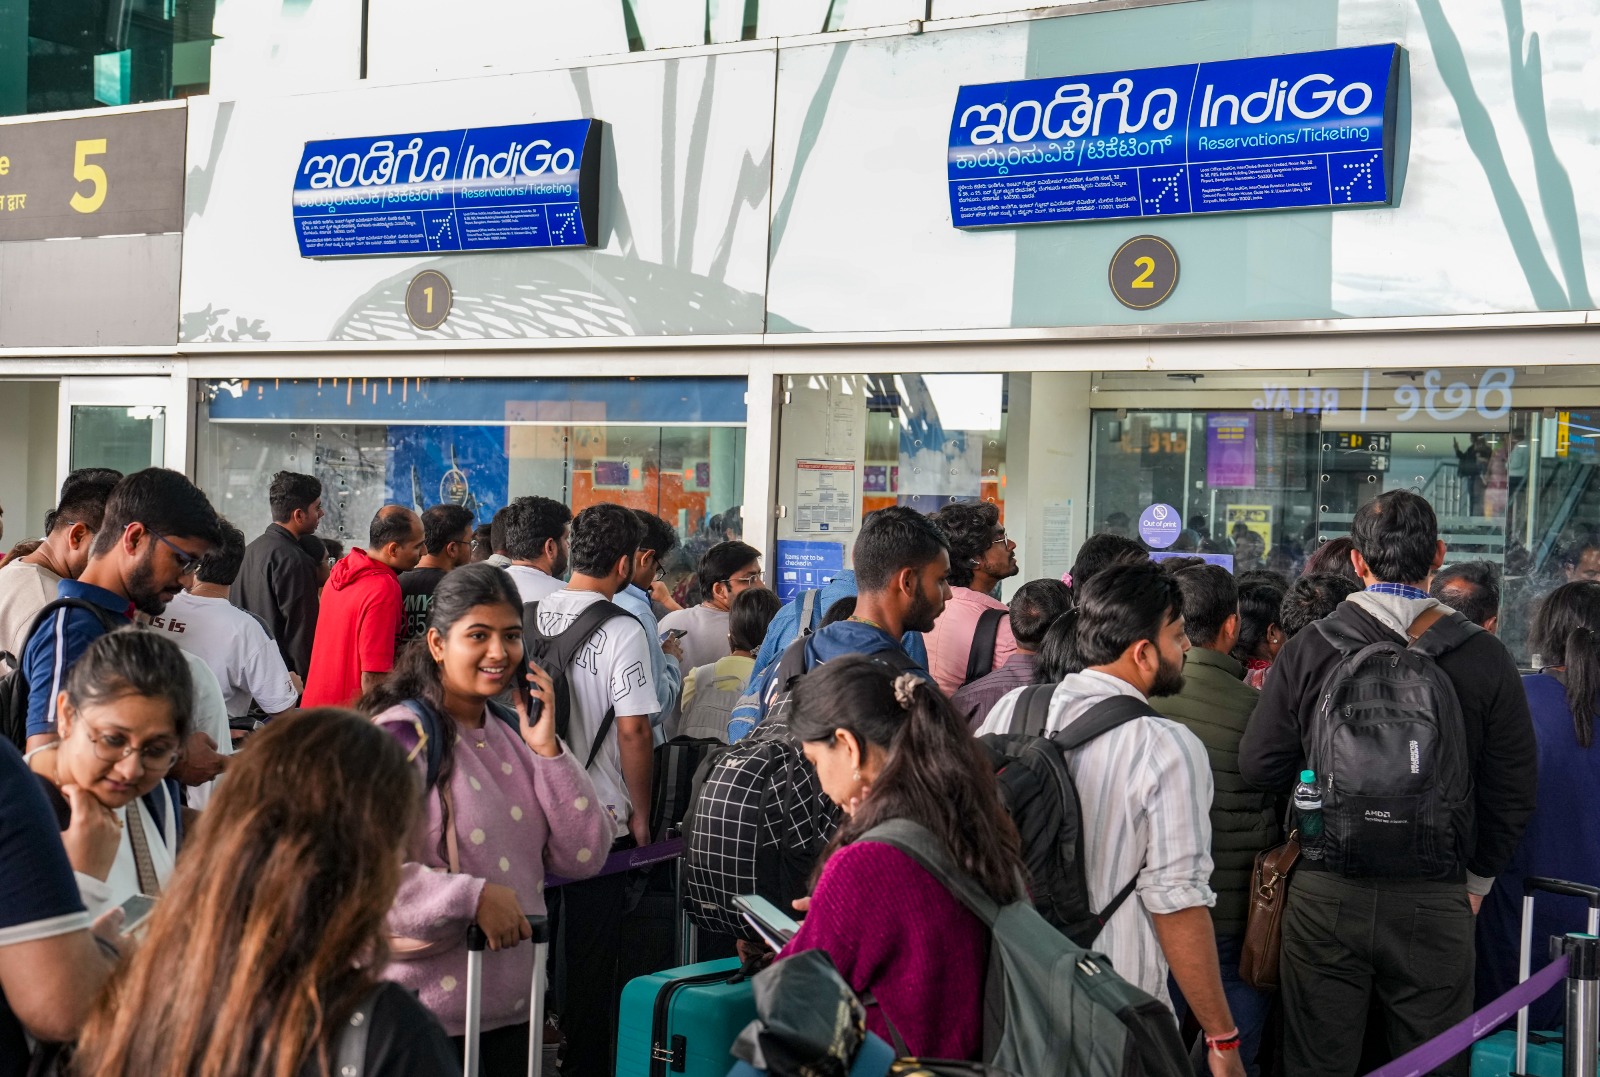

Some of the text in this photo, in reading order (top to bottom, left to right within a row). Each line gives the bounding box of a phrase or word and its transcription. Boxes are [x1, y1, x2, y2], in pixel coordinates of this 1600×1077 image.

[1200, 73, 1373, 128] IndiGo
[1199, 125, 1369, 150] Reservations/Ticketing
[462, 139, 575, 180] IndiGo
[69, 138, 108, 214] 5
[461, 182, 572, 199] Reservations/Ticketing
[1131, 256, 1155, 288] 2
[423, 286, 433, 313] 1
[1143, 519, 1155, 527] Out
[1163, 520, 1177, 529] print
